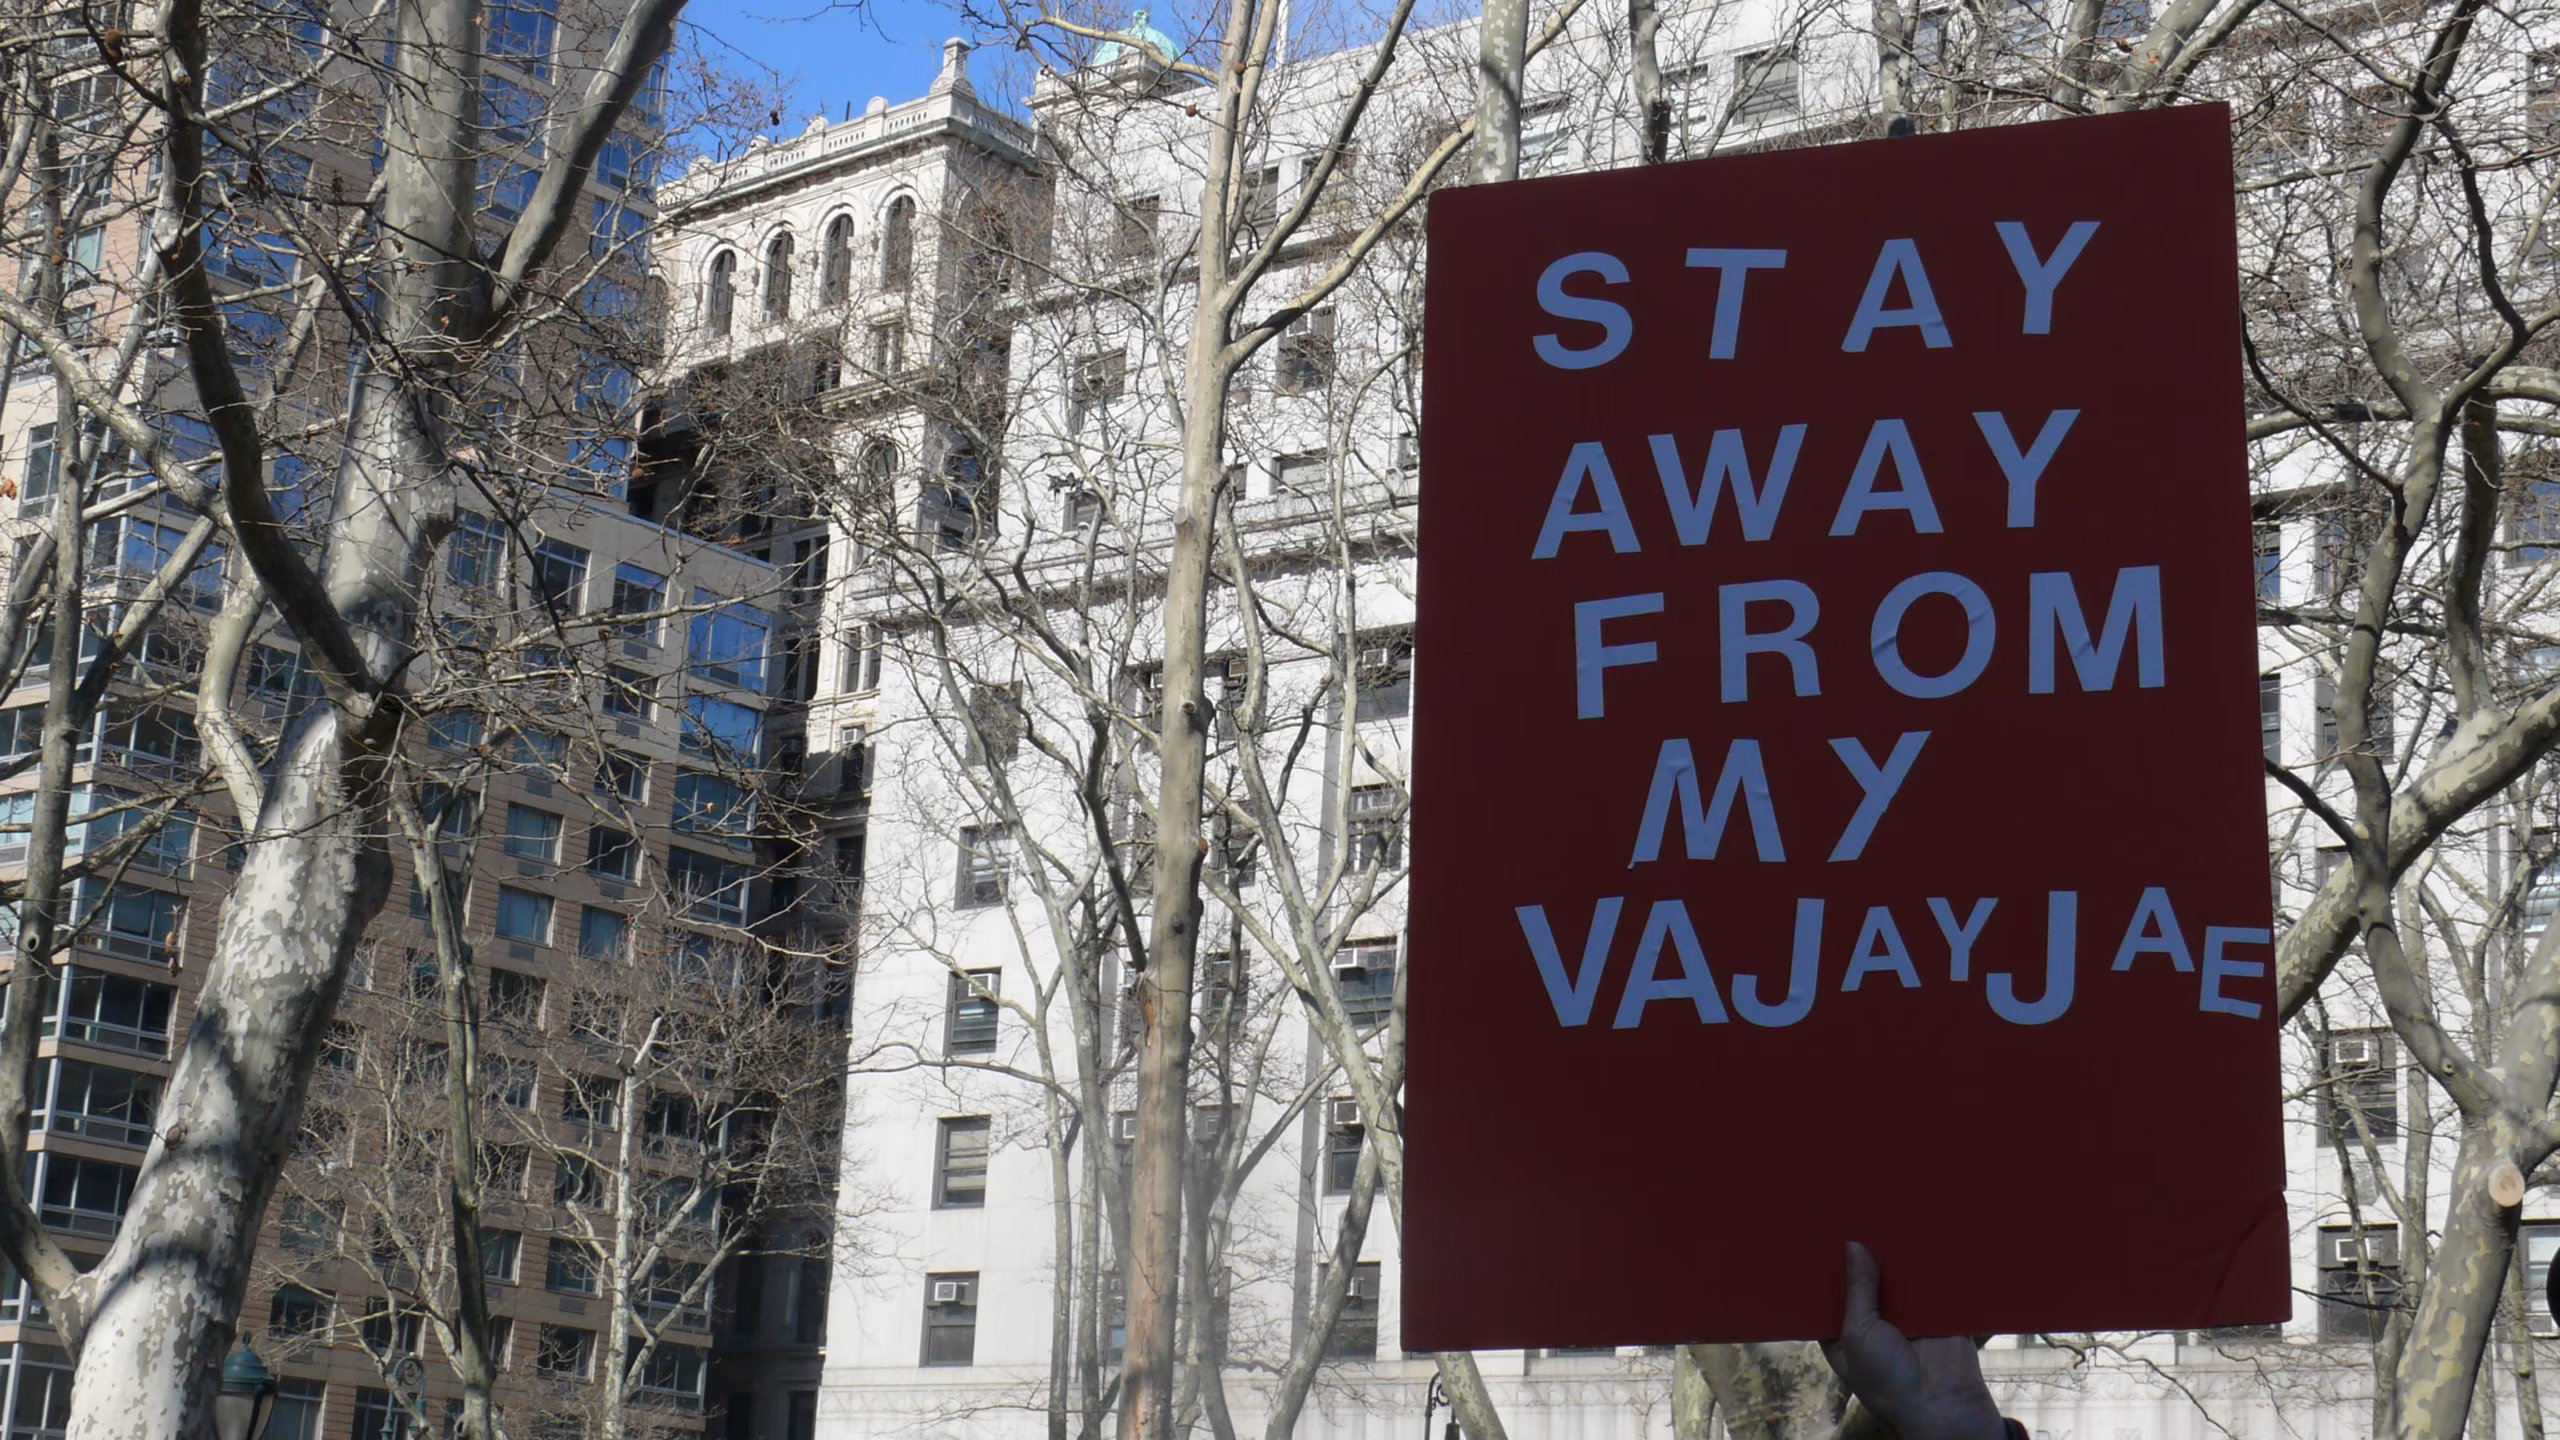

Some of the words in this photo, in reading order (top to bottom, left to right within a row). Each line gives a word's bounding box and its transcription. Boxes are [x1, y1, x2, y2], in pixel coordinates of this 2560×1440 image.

[1532, 221, 2101, 370] STAY
[1531, 409, 2081, 560] AWAY
[1574, 565, 2166, 719] FROM
[1627, 730, 1932, 869] MY
[1514, 886, 2272, 1030] VAJAYJAE
